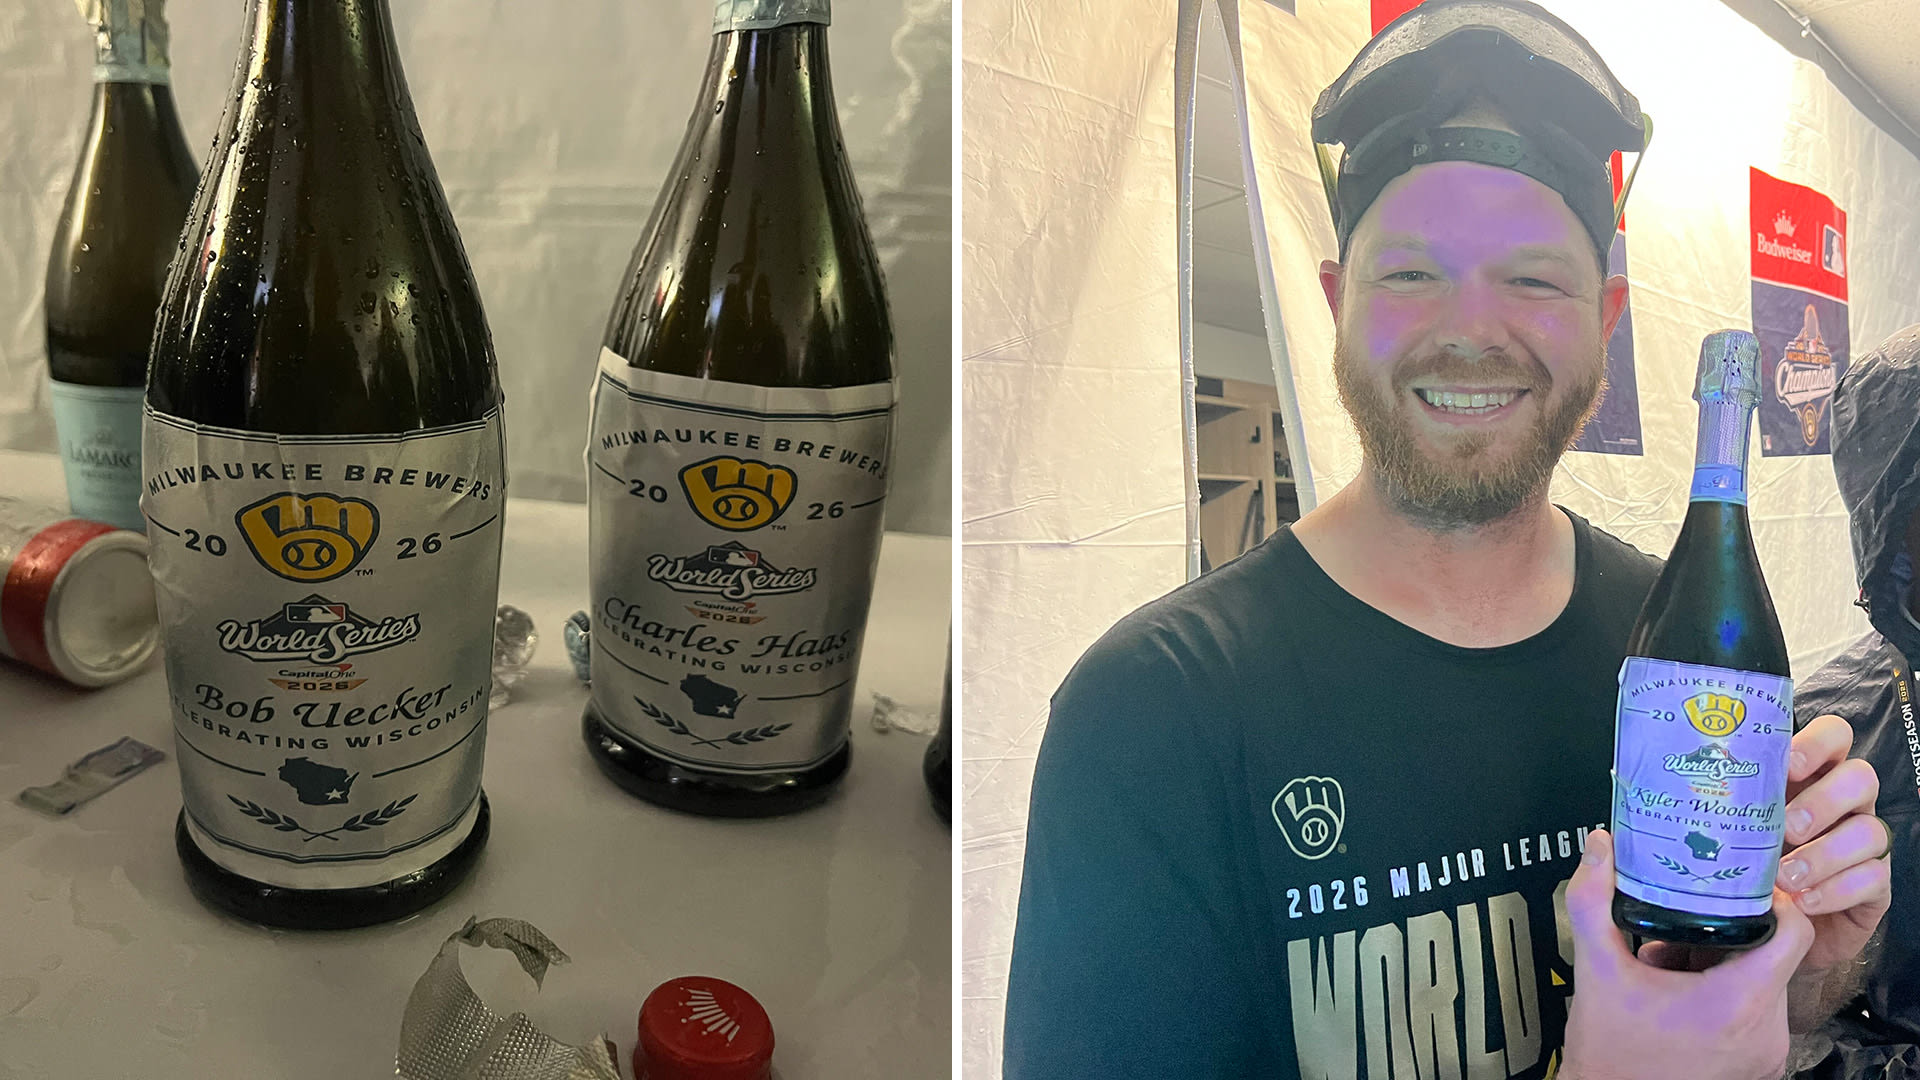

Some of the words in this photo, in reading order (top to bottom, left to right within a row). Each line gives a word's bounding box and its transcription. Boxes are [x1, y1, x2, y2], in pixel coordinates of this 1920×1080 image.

[1757, 232, 1812, 264] Budweiser
[602, 428, 760, 450] MILWAUKEE
[149, 462, 323, 497] MILWAUKEE
[345, 464, 491, 501] BREWERS
[629, 479, 668, 503] 20
[806, 501, 844, 520] 26
[184, 528, 227, 556] 20
[396, 532, 442, 559] 26
[592, 603, 726, 671] LEBRATING
[741, 648, 856, 675] WISCONSI
[604, 597, 739, 656] Charles
[749, 629, 850, 659] Haas
[195, 684, 275, 724] Bob
[293, 683, 452, 728] Uecker
[287, 681, 349, 691] 2026
[1631, 677, 1726, 698] MILWAUKEE
[1735, 683, 1790, 719] BREWERS
[174, 694, 329, 750] LEBRATING
[345, 685, 484, 749] WISCONSIN
[1652, 709, 1676, 722] 20
[1752, 722, 1772, 735] 26
[1620, 801, 1712, 828] CLEBRATING
[1630, 786, 1683, 807] Kyler
[1689, 798, 1777, 823] Woodruff
[1286, 876, 1369, 919] 2026
[1389, 848, 1486, 898] MAJOR
[1502, 822, 1606, 871] LEAGU
[1287, 891, 1543, 1080] WORLD
